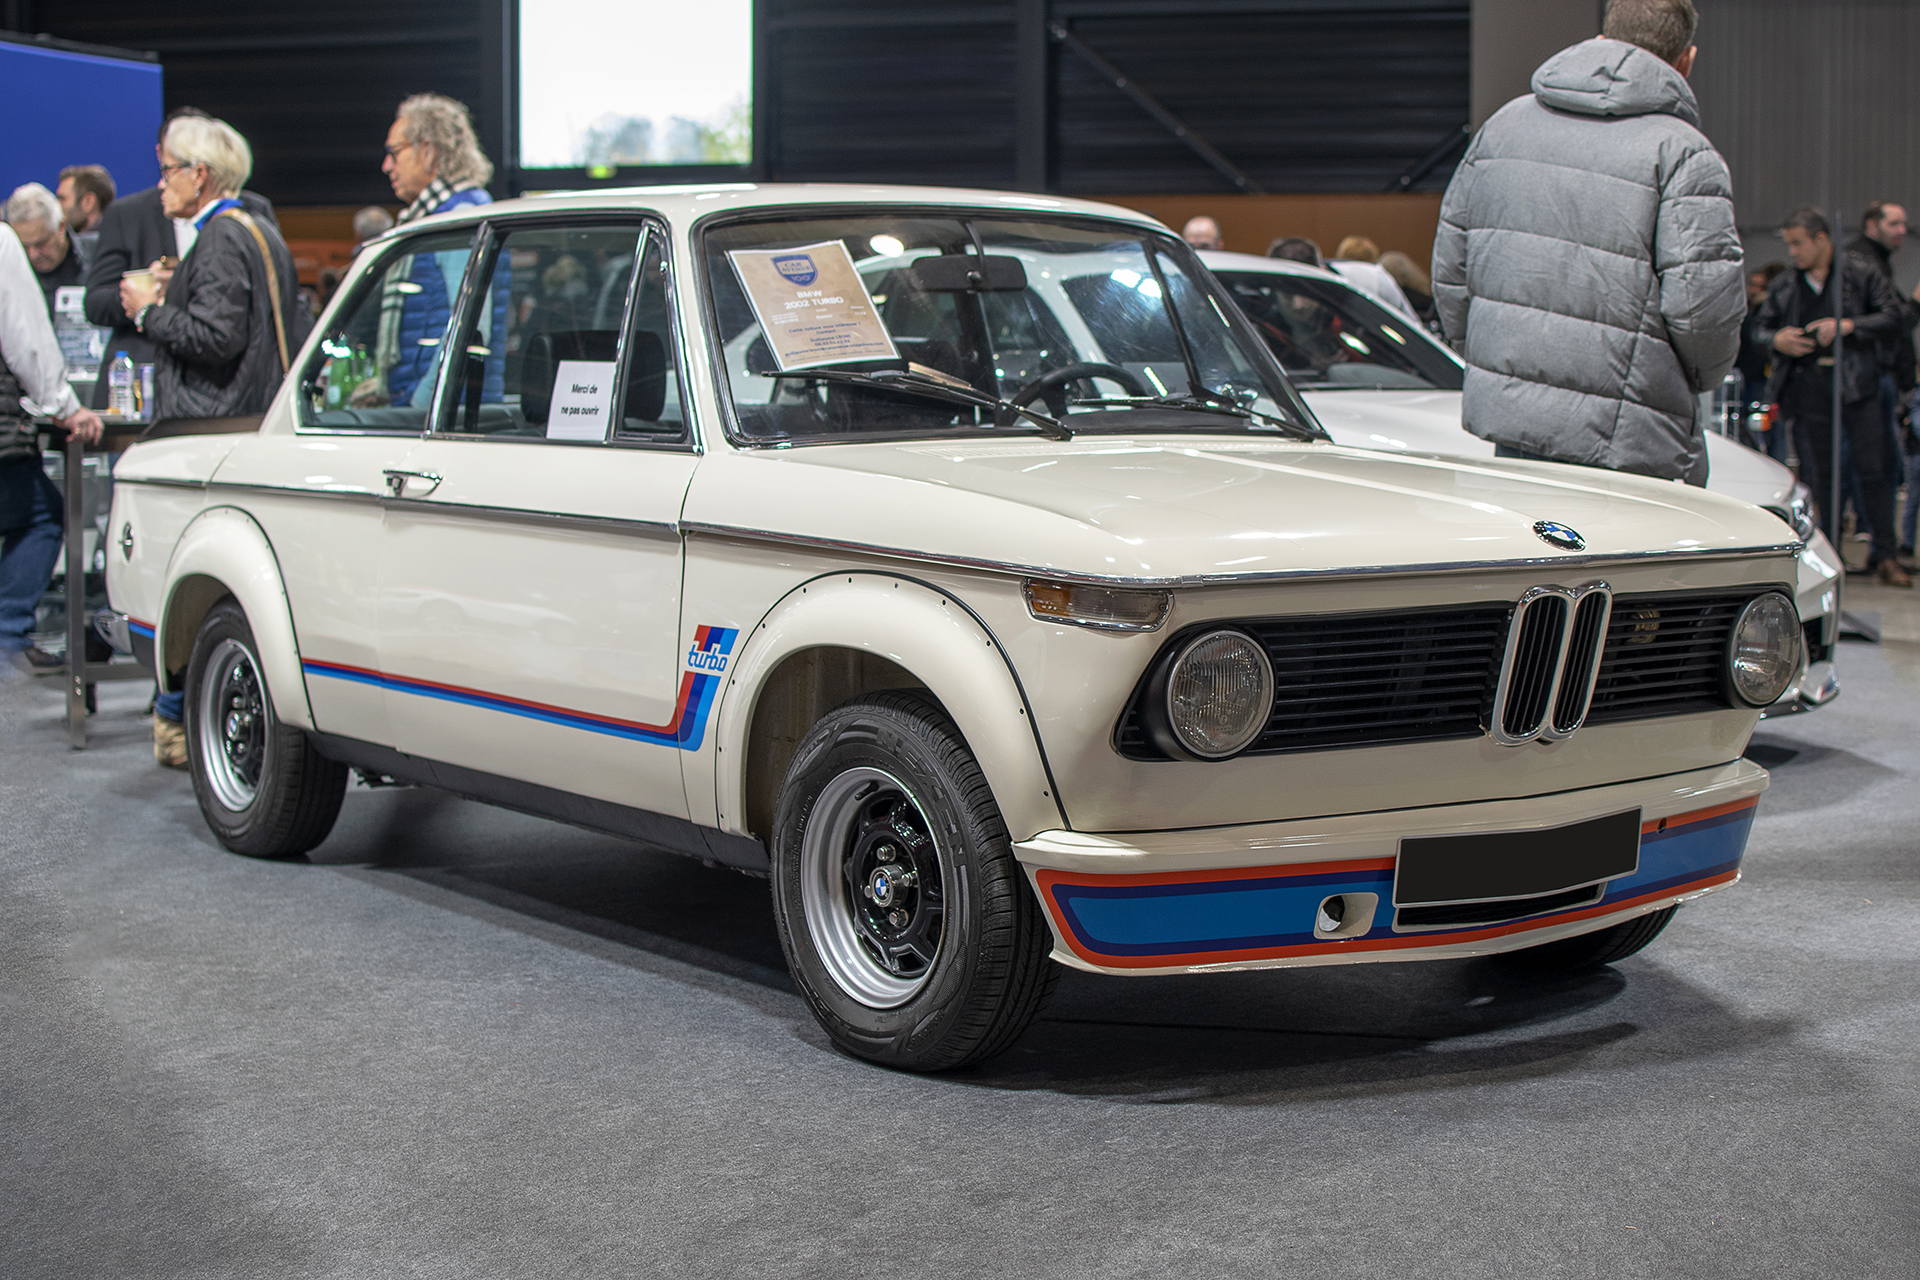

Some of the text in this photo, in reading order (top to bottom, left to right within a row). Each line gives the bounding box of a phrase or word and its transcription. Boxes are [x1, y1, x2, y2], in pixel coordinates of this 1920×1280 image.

[781, 265, 811, 273] AVENUE
[796, 290, 822, 298] BMW
[784, 296, 844, 310] 2002 TURBO
[571, 384, 597, 394] Merci de
[561, 405, 599, 416] ne pas ouvrir
[688, 644, 728, 672] turbo
[876, 727, 967, 868] NEXEN
